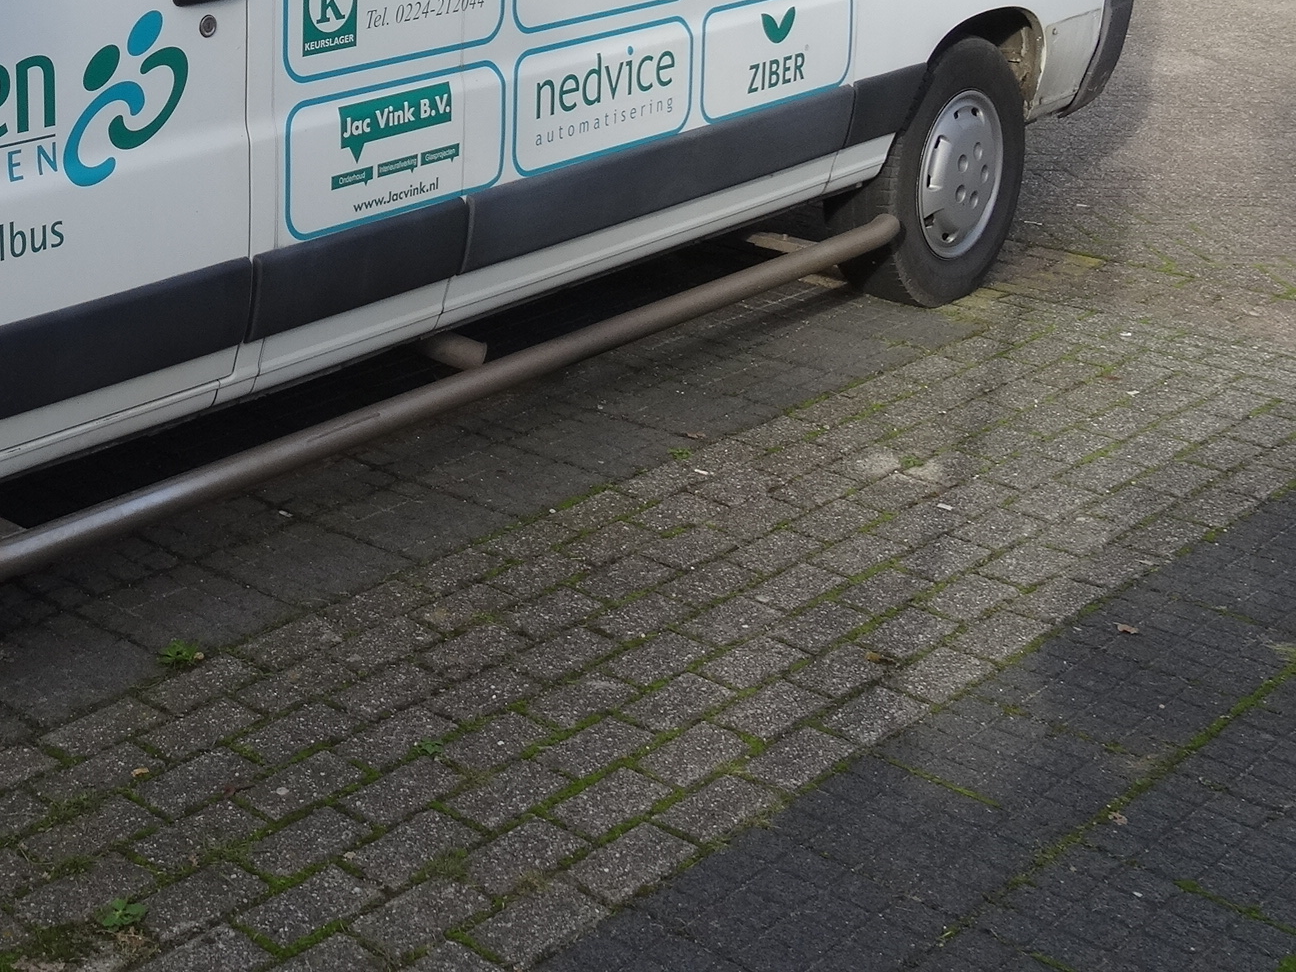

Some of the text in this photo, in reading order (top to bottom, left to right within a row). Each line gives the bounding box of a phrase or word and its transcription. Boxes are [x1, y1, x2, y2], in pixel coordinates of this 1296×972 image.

[366, 7, 390, 29] Tel.
[304, 33, 355, 52] KEURSLAGER
[535, 46, 676, 120] nedvice
[747, 52, 805, 95] ZIBER
[343, 93, 451, 139] Jac Vink B.V.
[535, 95, 674, 147] automatisering
[353, 177, 439, 212] www.Jacvink.nl
